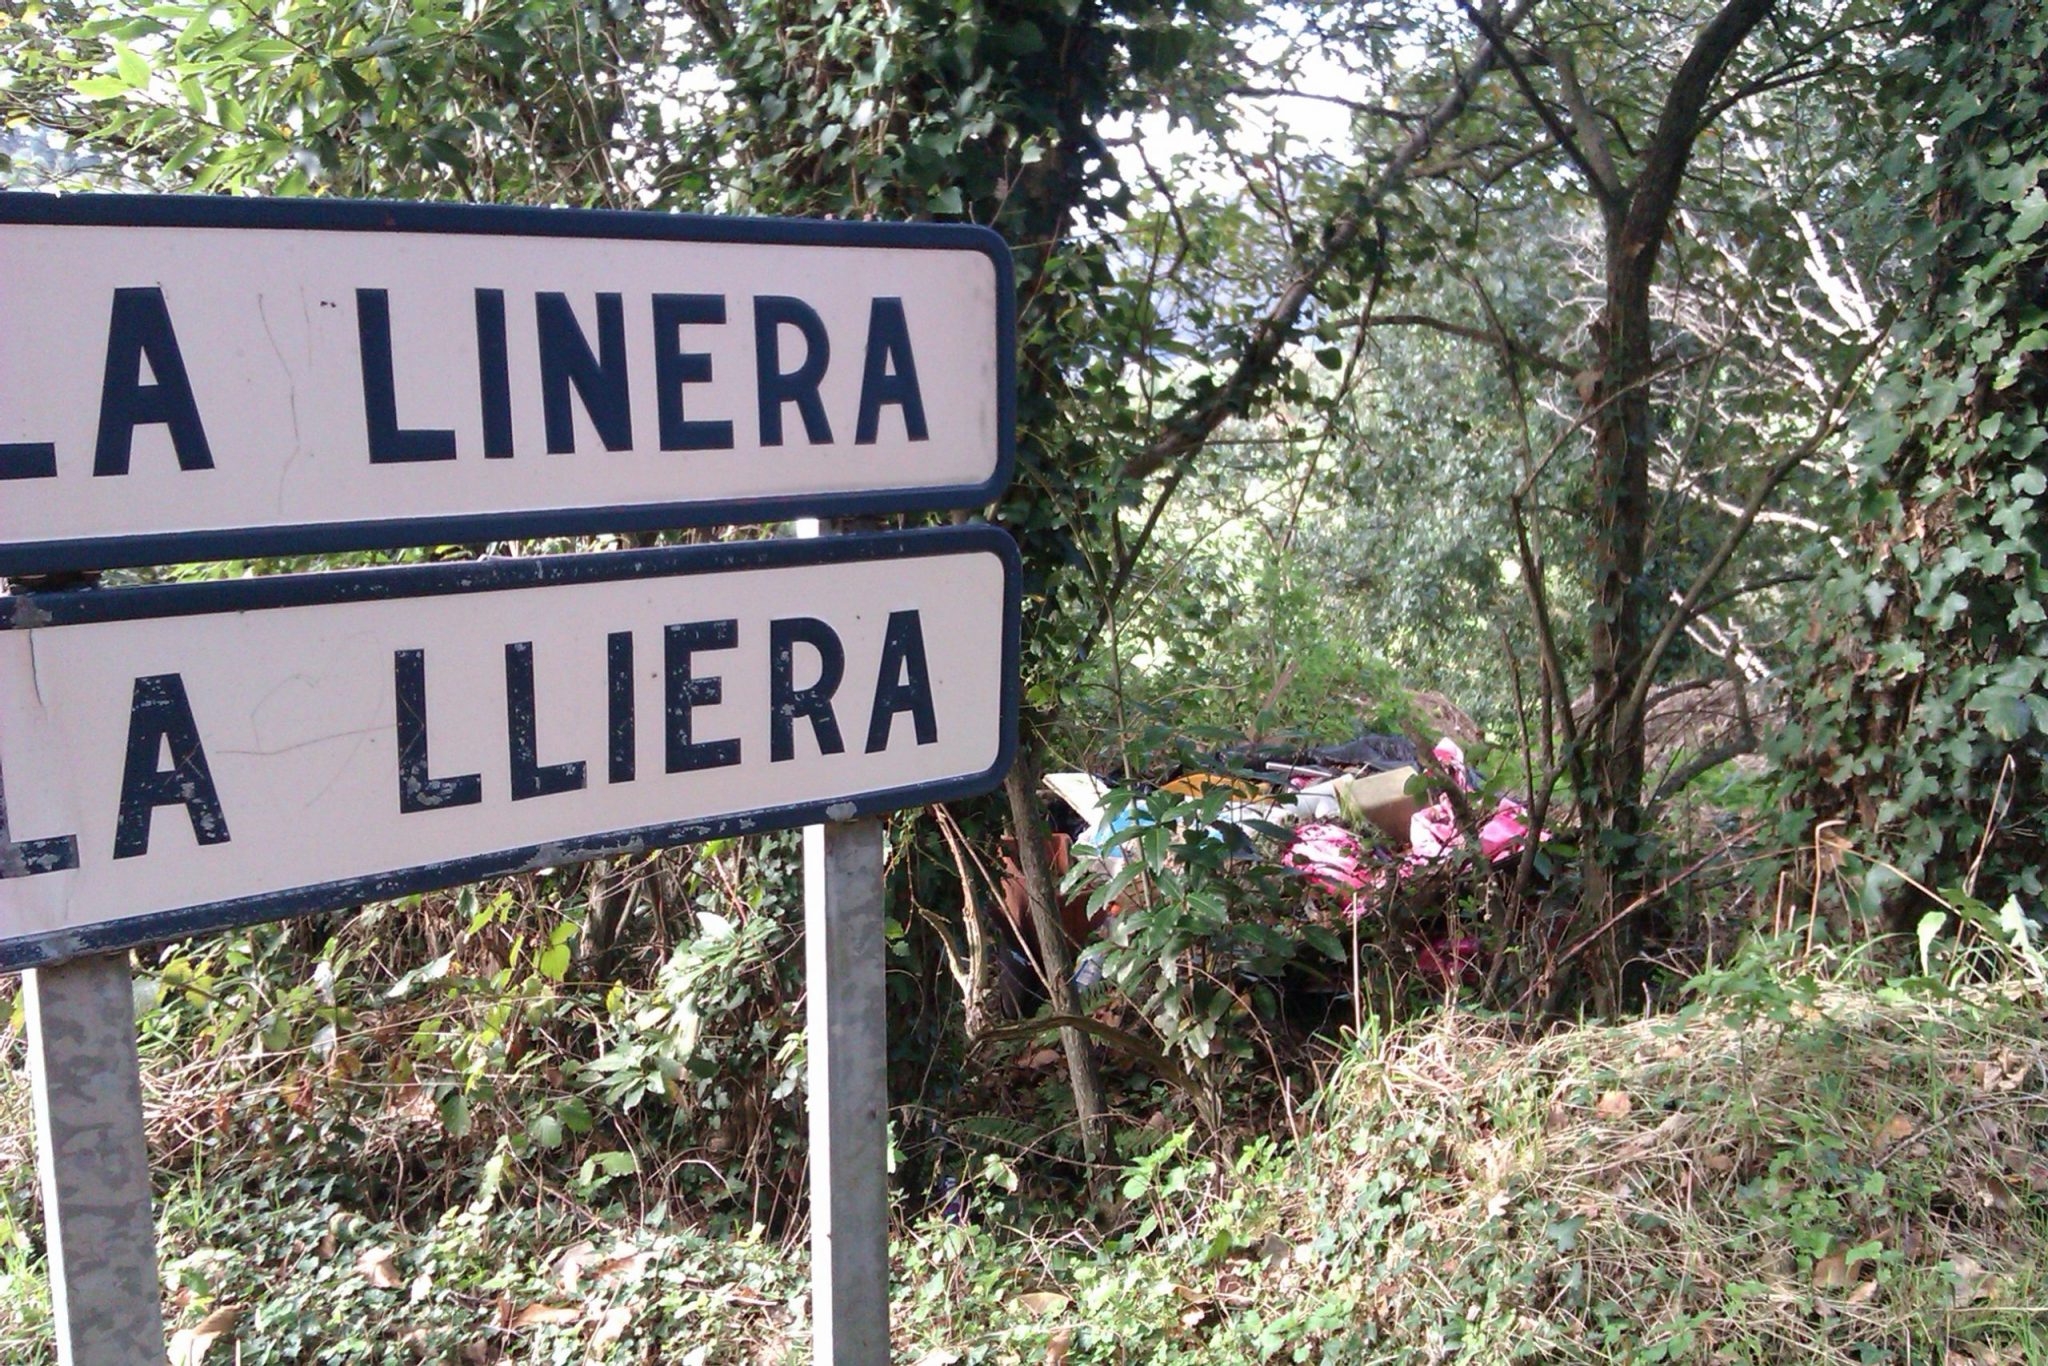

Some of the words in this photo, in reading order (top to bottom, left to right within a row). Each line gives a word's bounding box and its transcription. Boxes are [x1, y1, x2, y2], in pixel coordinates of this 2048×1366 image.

[0, 286, 215, 480] A
[355, 287, 929, 465] LINERA
[394, 609, 938, 815] LLIERA
